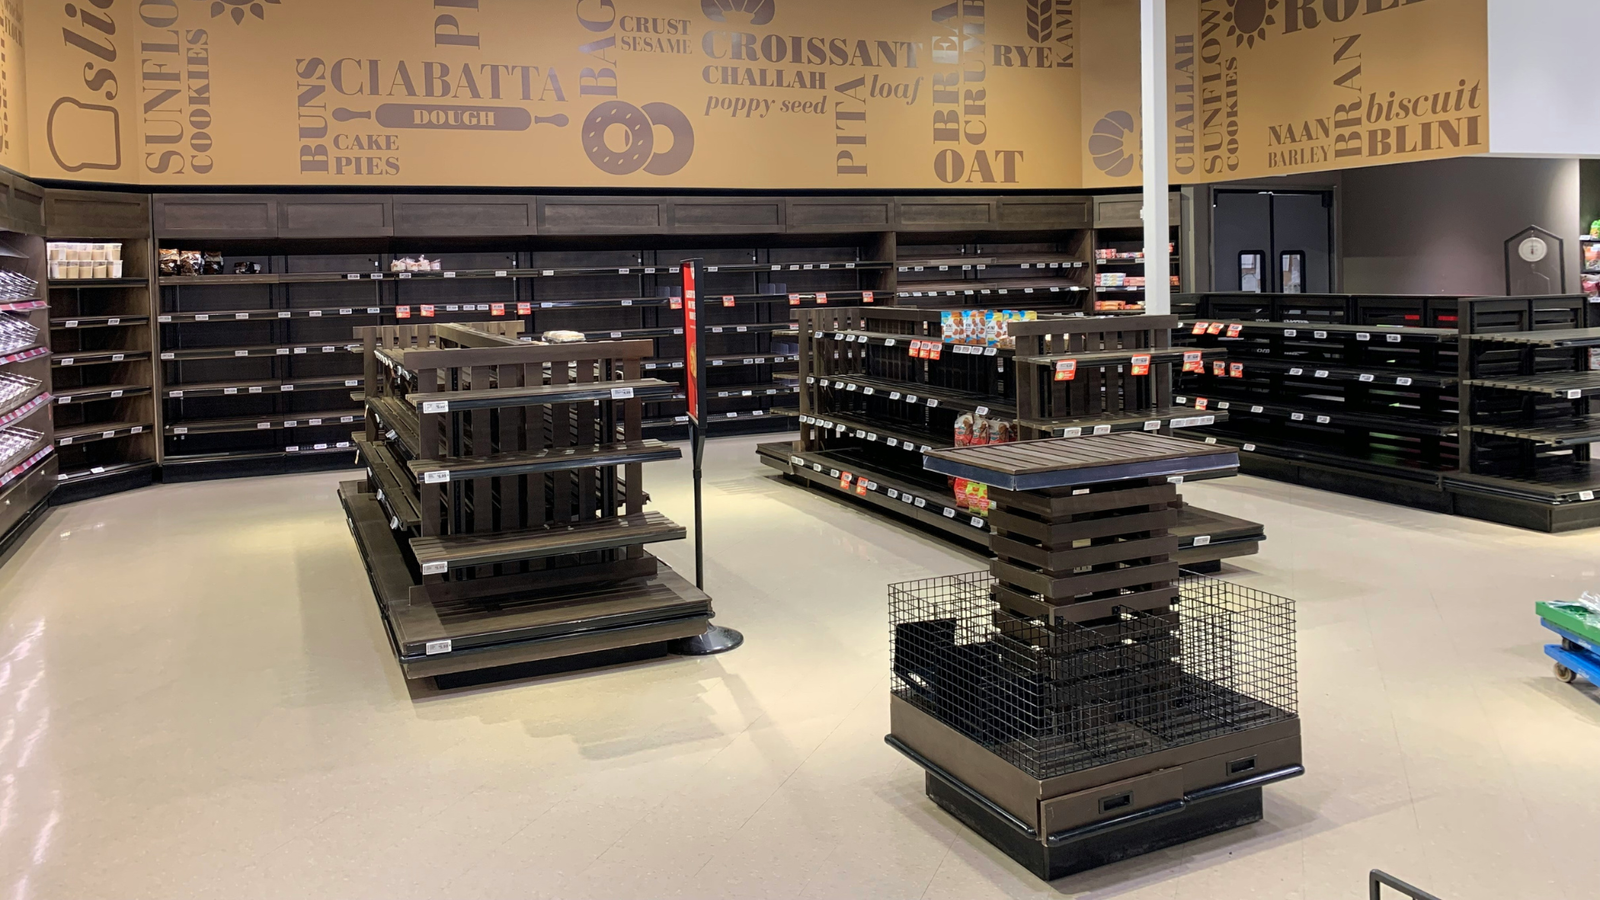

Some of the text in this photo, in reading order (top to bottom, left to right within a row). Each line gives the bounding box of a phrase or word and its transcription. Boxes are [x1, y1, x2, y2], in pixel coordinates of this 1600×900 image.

[619, 15, 692, 36] CRUST
[620, 36, 693, 55] SESAME
[701, 30, 923, 69] CROISSANT
[992, 43, 1053, 69] RYE
[139, 0, 186, 175] SUNFLO
[330, 57, 569, 103] CIABATTA
[701, 64, 827, 90] CHALLAH
[870, 74, 924, 105] loaf
[1200, 0, 1223, 174] SUNFLOW
[185, 28, 214, 175] COOKIES
[704, 94, 828, 118] poppy seed
[1174, 33, 1196, 175] CHALLAH
[1225, 56, 1240, 172] COOKIES
[1333, 33, 1363, 160] BRAN
[1366, 78, 1482, 125] biscuit
[295, 57, 329, 175] BUNS
[412, 108, 497, 127] DOUGH
[834, 73, 868, 177] PITA
[1267, 116, 1332, 147] NAAN
[332, 133, 400, 151] CAKE
[1366, 114, 1483, 158] BLINI
[333, 156, 400, 175] PIES
[933, 148, 1024, 184] OAT
[1267, 143, 1331, 169] BARLEY
